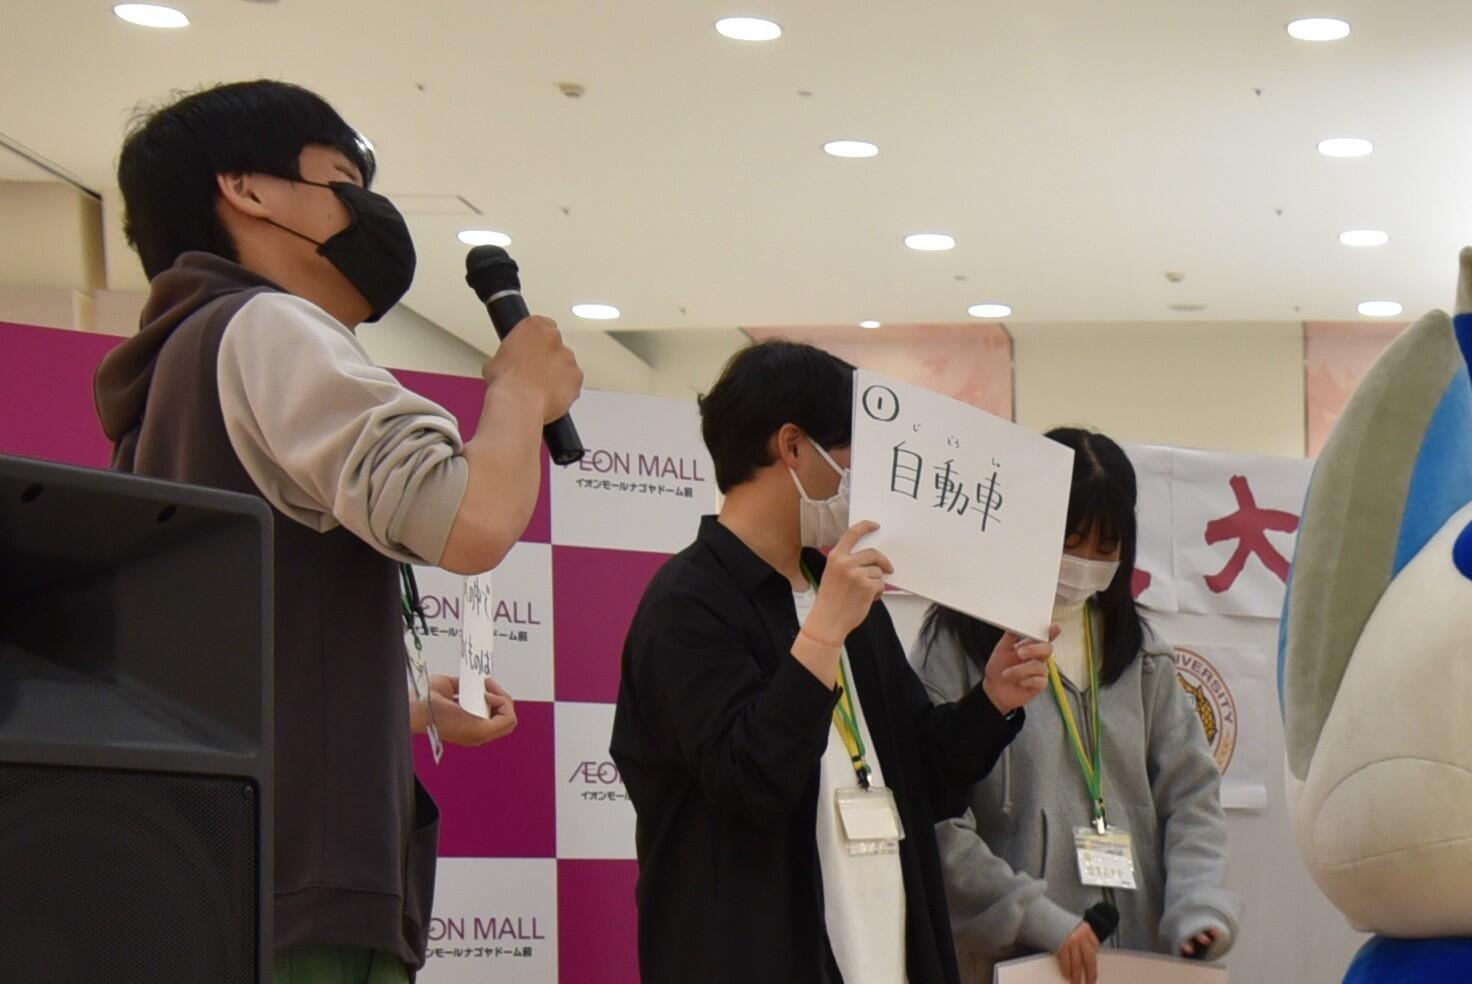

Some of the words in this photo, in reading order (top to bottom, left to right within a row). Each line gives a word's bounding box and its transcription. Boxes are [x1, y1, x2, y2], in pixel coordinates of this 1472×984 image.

[638, 453, 706, 482] MALL
[890, 440, 1004, 532] 自動車
[1204, 474, 1300, 594] 大
[493, 600, 541, 625] ALL
[1175, 654, 1234, 724] IVERSITY
[581, 791, 630, 801] イオンモー
[474, 917, 546, 940] MALL
